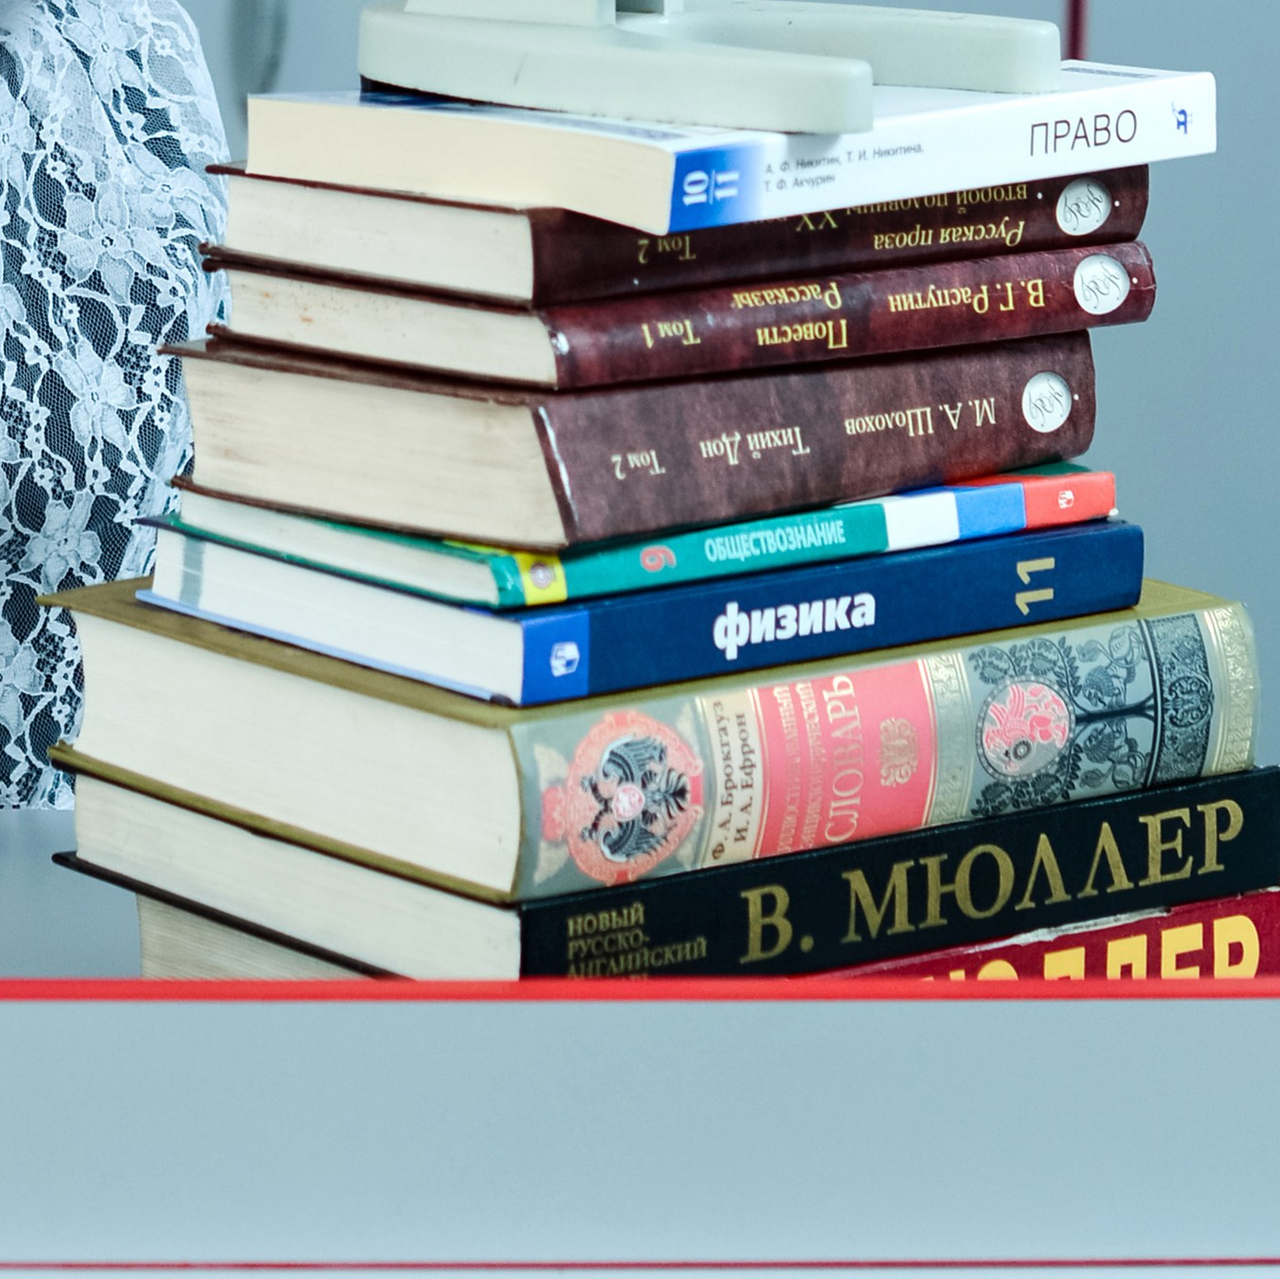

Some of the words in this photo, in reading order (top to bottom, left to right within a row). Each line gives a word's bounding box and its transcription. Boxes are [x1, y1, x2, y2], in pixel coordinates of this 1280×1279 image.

[1030, 109, 1137, 156] ПРАВО
[682, 169, 710, 207] 10
[714, 170, 740, 199] 11
[792, 172, 836, 190] Акчурин
[873, 225, 936, 251] проза
[939, 216, 1025, 247] Русская
[637, 238, 650, 264] 2
[658, 235, 697, 261] Том
[732, 281, 842, 310] Рассказы
[888, 286, 990, 315] Распутин
[995, 282, 1016, 313] Г.
[1022, 279, 1045, 308] В.
[644, 323, 655, 349] 1
[657, 318, 701, 345] Том
[756, 318, 849, 349] Повести
[844, 405, 934, 438] Шолохов
[937, 401, 962, 430] А.
[967, 396, 997, 425] М.
[699, 430, 742, 466] Дон
[746, 425, 811, 459] Тихий
[610, 453, 626, 480] 2
[628, 448, 666, 476] Том
[704, 518, 846, 563] ОБЩЕСТВОЗНАНИЕ
[1014, 556, 1055, 615] 11
[712, 592, 877, 660] физика
[710, 700, 738, 808] Брокгауз
[733, 713, 756, 789] Ефрон
[821, 675, 865, 843] СЛОВАРЬ
[738, 796, 753, 815] А.
[718, 812, 732, 832] А.
[733, 819, 750, 843] И.
[739, 884, 815, 964] В.
[841, 798, 1244, 942] МЮЛЛЕР
[567, 901, 645, 937] НОВЫЙ
[568, 929, 650, 960] РУССКО-
[568, 936, 708, 980] АНГЛИЙСКИЙ
